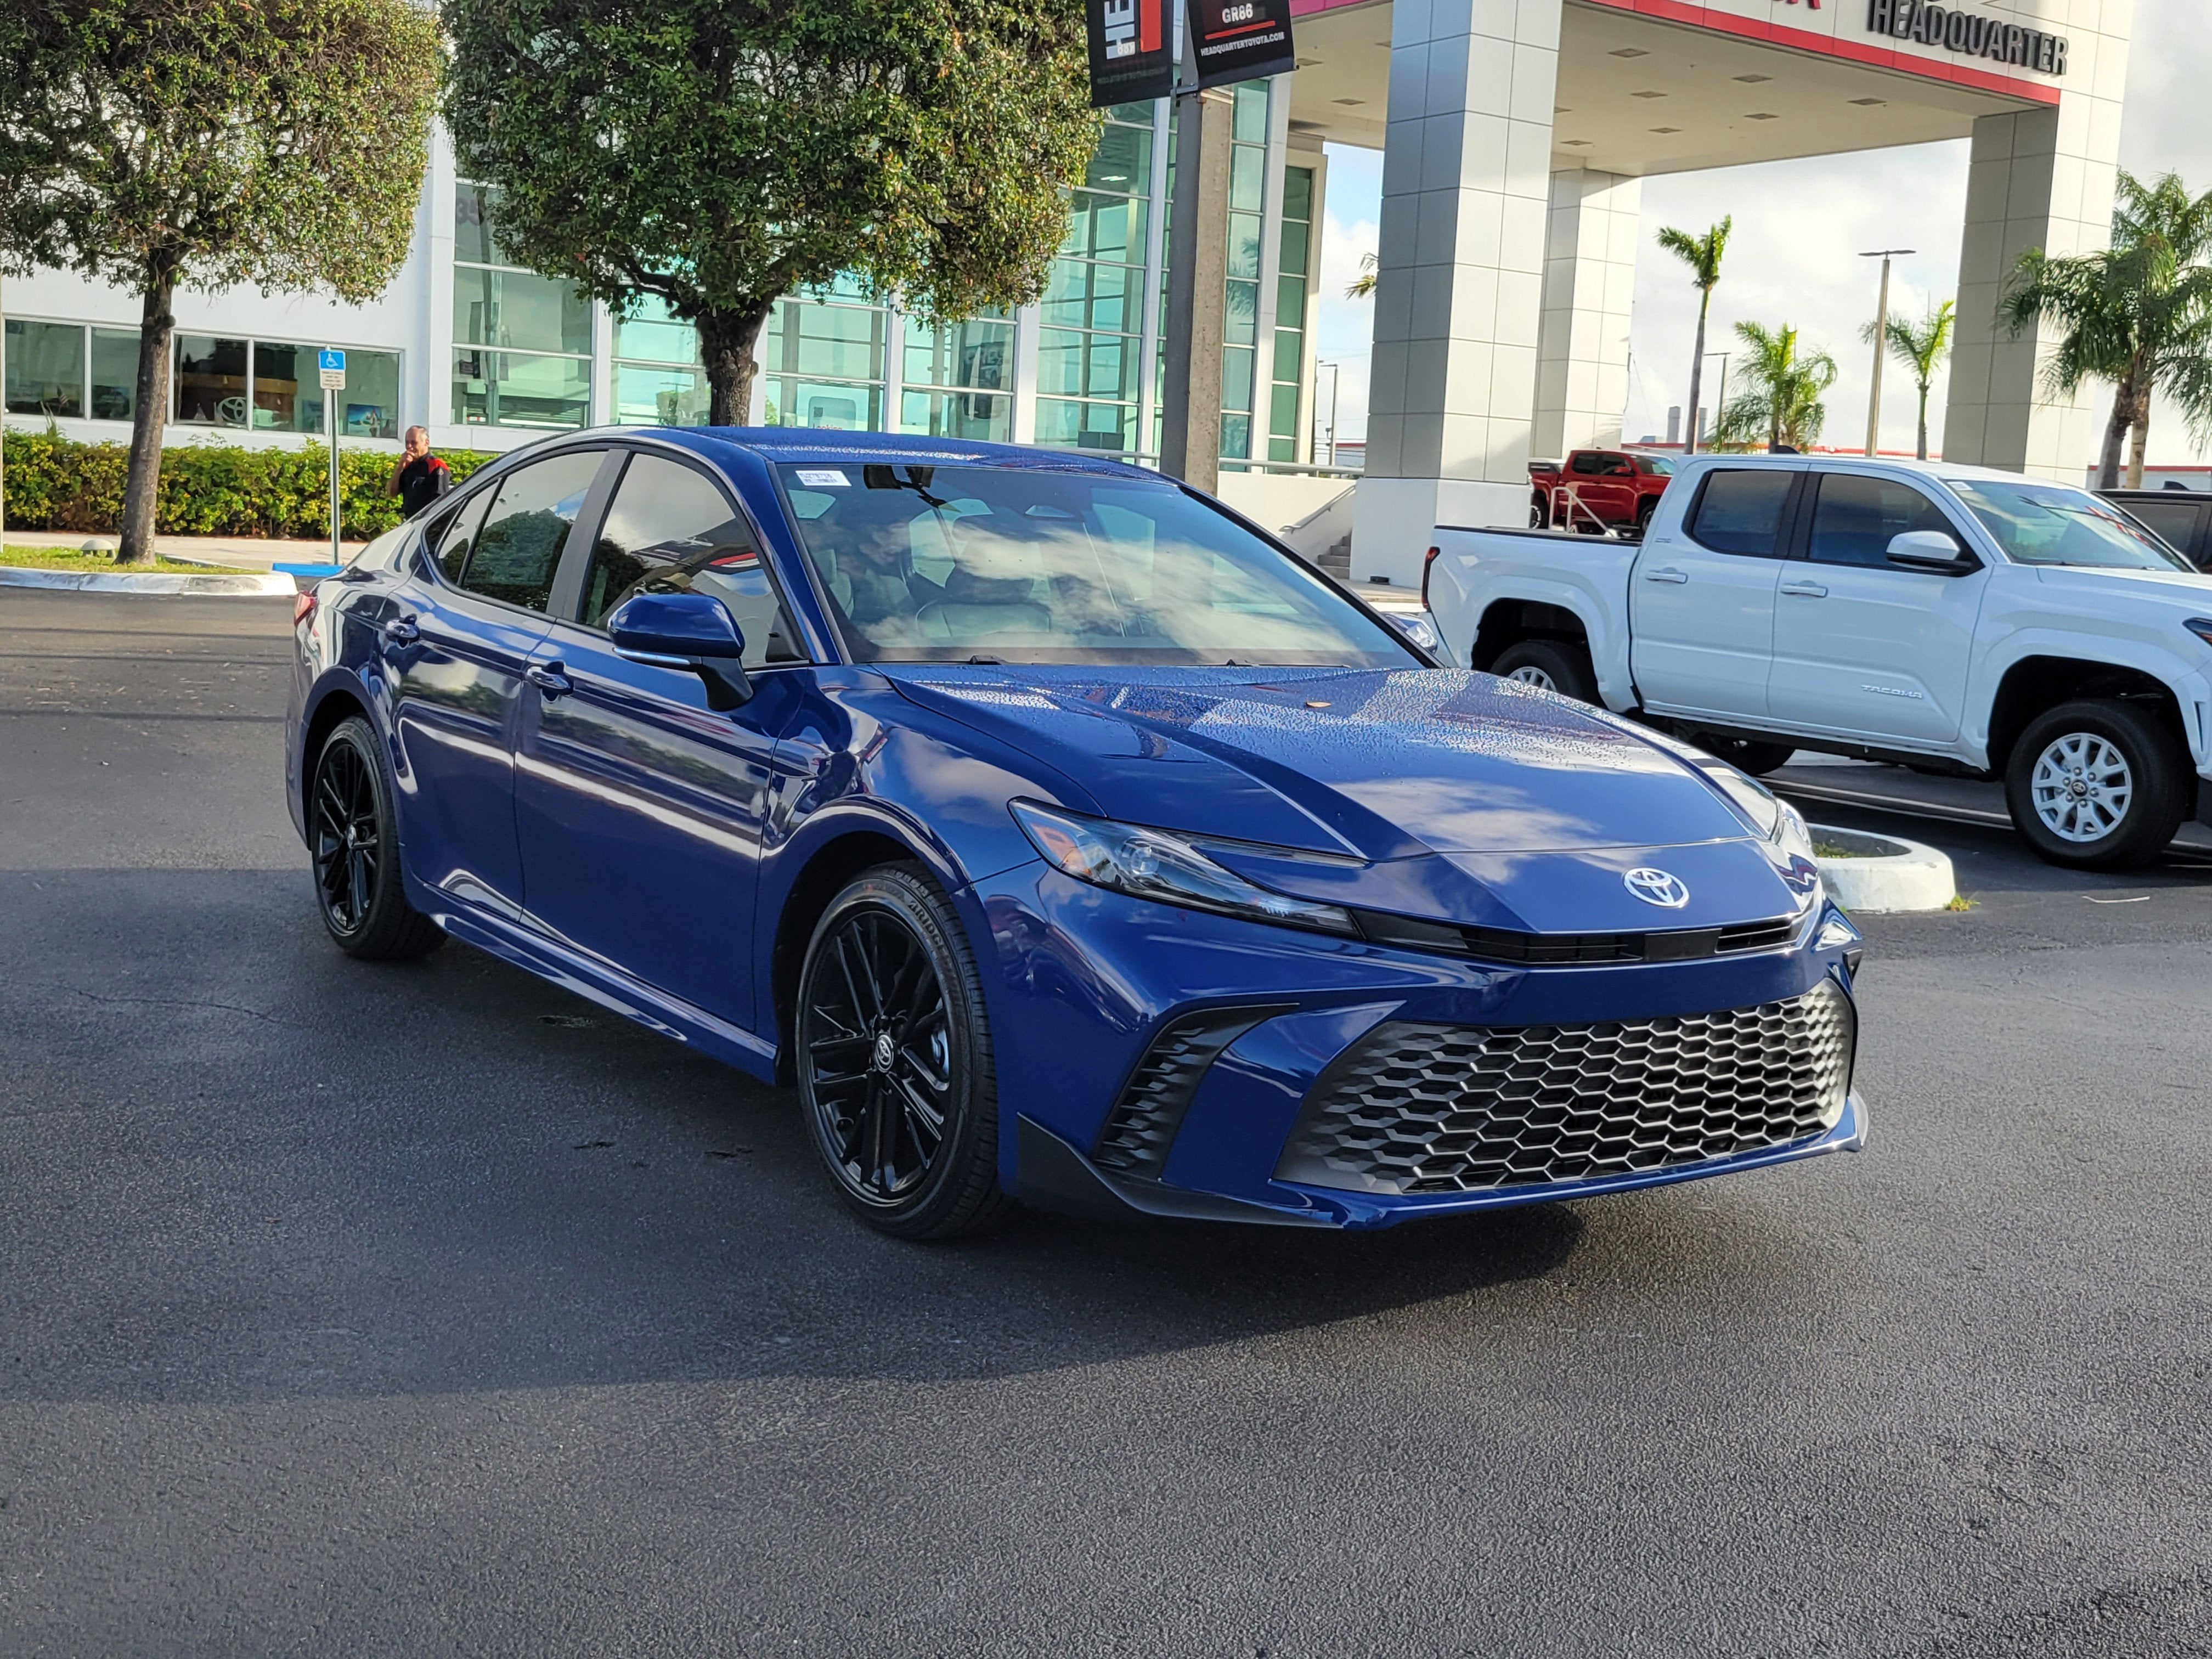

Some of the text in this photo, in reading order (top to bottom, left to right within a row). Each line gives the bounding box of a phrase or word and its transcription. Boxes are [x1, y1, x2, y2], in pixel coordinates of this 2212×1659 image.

[1222, 3, 1254, 24] GR86
[1200, 31, 1285, 57] HEADQUARTERTOYOTA.COM
[1866, 0, 2069, 75] HEADQUARTER
[1860, 685, 1923, 699] TACOMA
